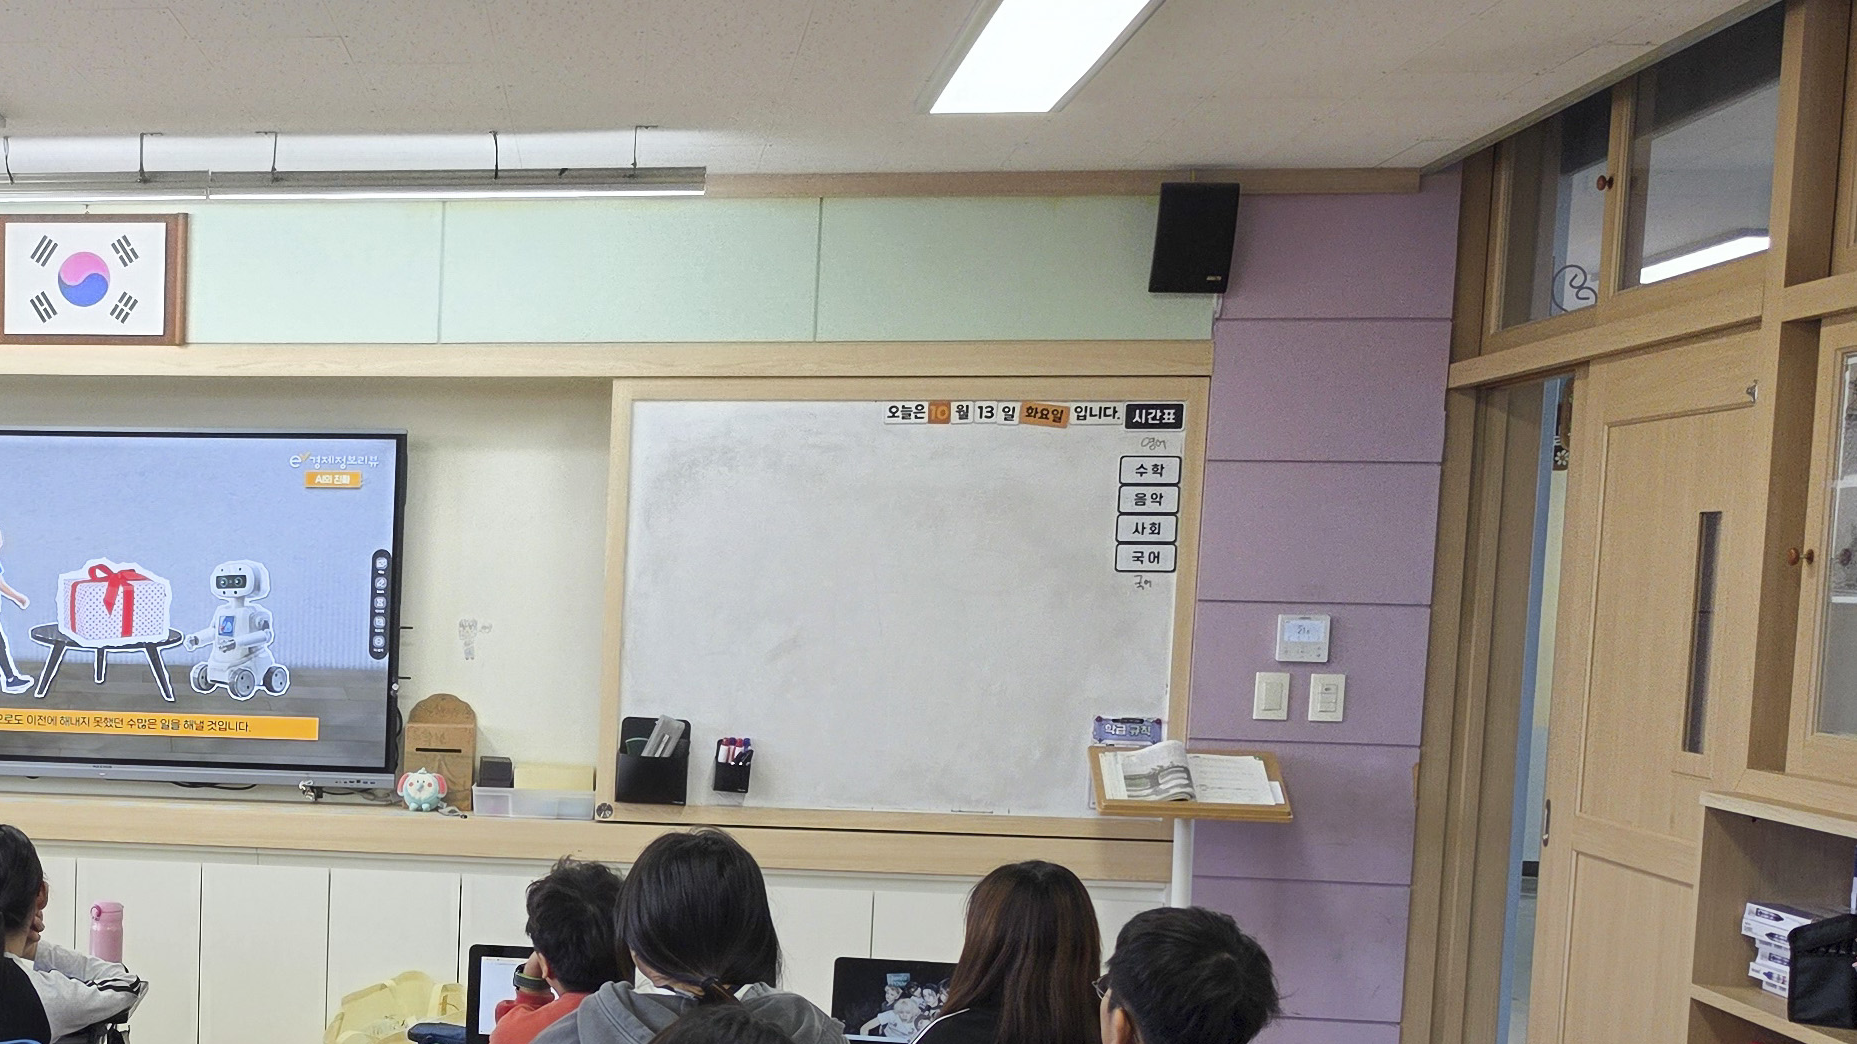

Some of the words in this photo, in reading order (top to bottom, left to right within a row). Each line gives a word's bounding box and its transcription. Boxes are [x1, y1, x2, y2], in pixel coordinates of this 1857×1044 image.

[887, 404, 926, 420] 오늘은
[956, 404, 970, 420] 월
[978, 405, 994, 419] 13
[1001, 406, 1016, 421] 일
[1025, 406, 1064, 423] 화요일
[1074, 405, 1120, 420] 입니다.
[1132, 408, 1176, 424] 시간표
[1140, 437, 1167, 450] 영어
[310, 455, 379, 470] 경제정보리뷰
[1135, 463, 1165, 477] 수학
[1134, 492, 1163, 506] 음악
[1132, 521, 1161, 536] 사회
[1132, 550, 1160, 565] 국어
[26, 714, 58, 727] 이전에
[59, 715, 91, 727] 해내지
[93, 716, 123, 729] 못했던
[126, 717, 158, 730] 수많은
[160, 719, 180, 731] 일을
[183, 719, 205, 732] 해낼
[207, 720, 252, 733] 것입니다.
